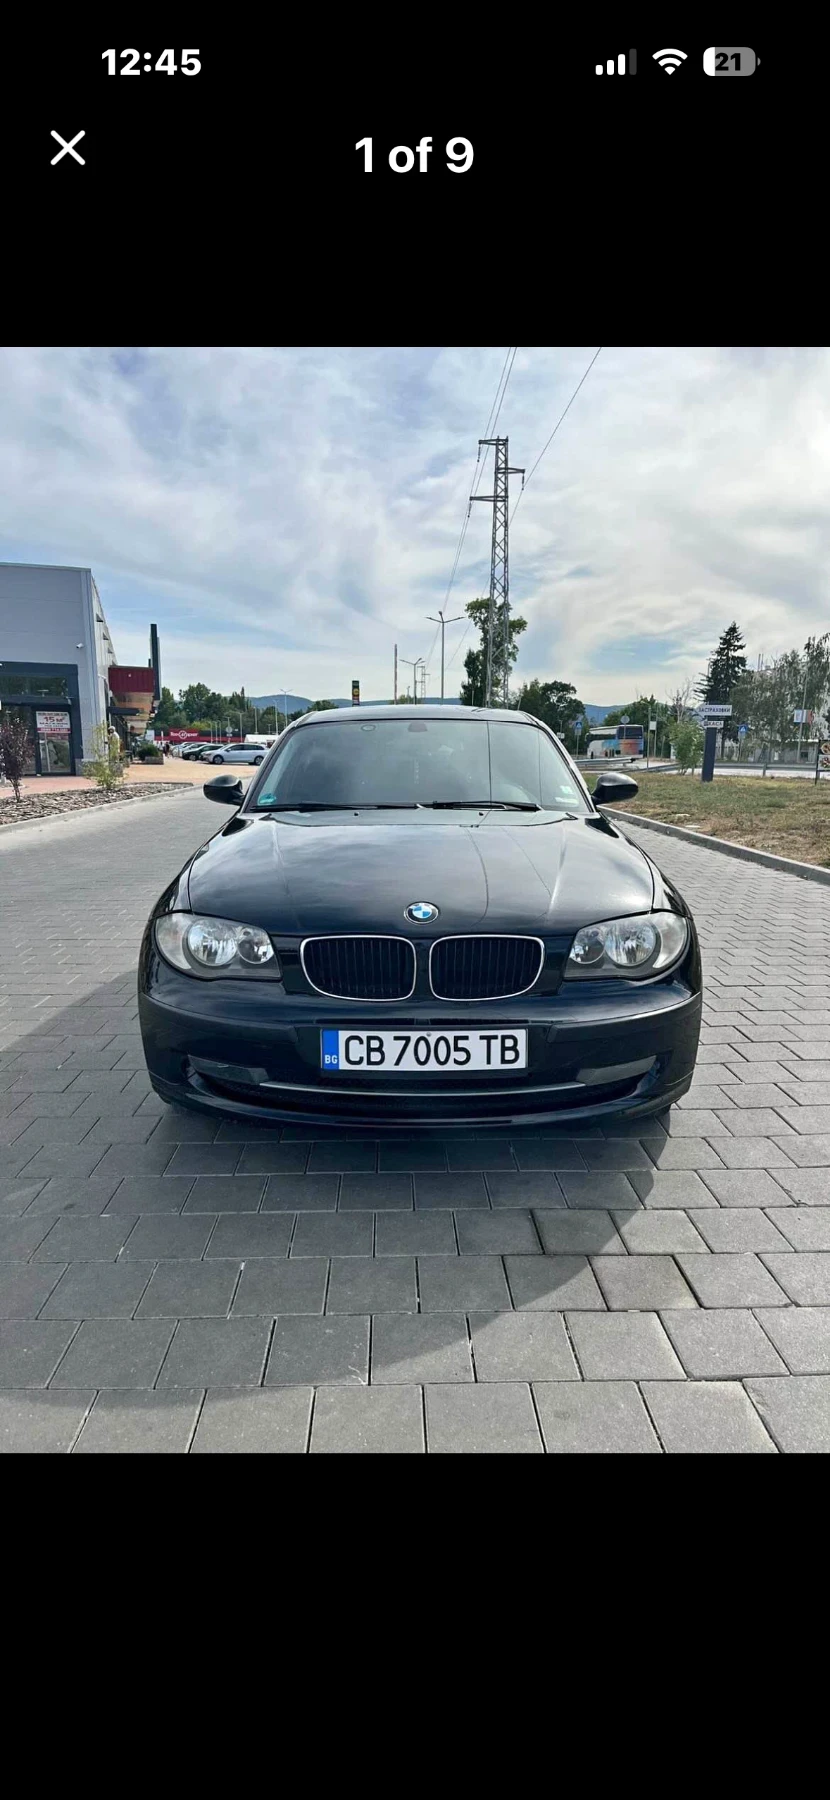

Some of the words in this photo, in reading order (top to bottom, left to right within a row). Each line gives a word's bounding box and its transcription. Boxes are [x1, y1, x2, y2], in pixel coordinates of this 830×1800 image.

[324, 1054, 338, 1064] BG
[344, 1034, 386, 1066] CB
[393, 1034, 472, 1067] 7005
[479, 1034, 520, 1066] TB
